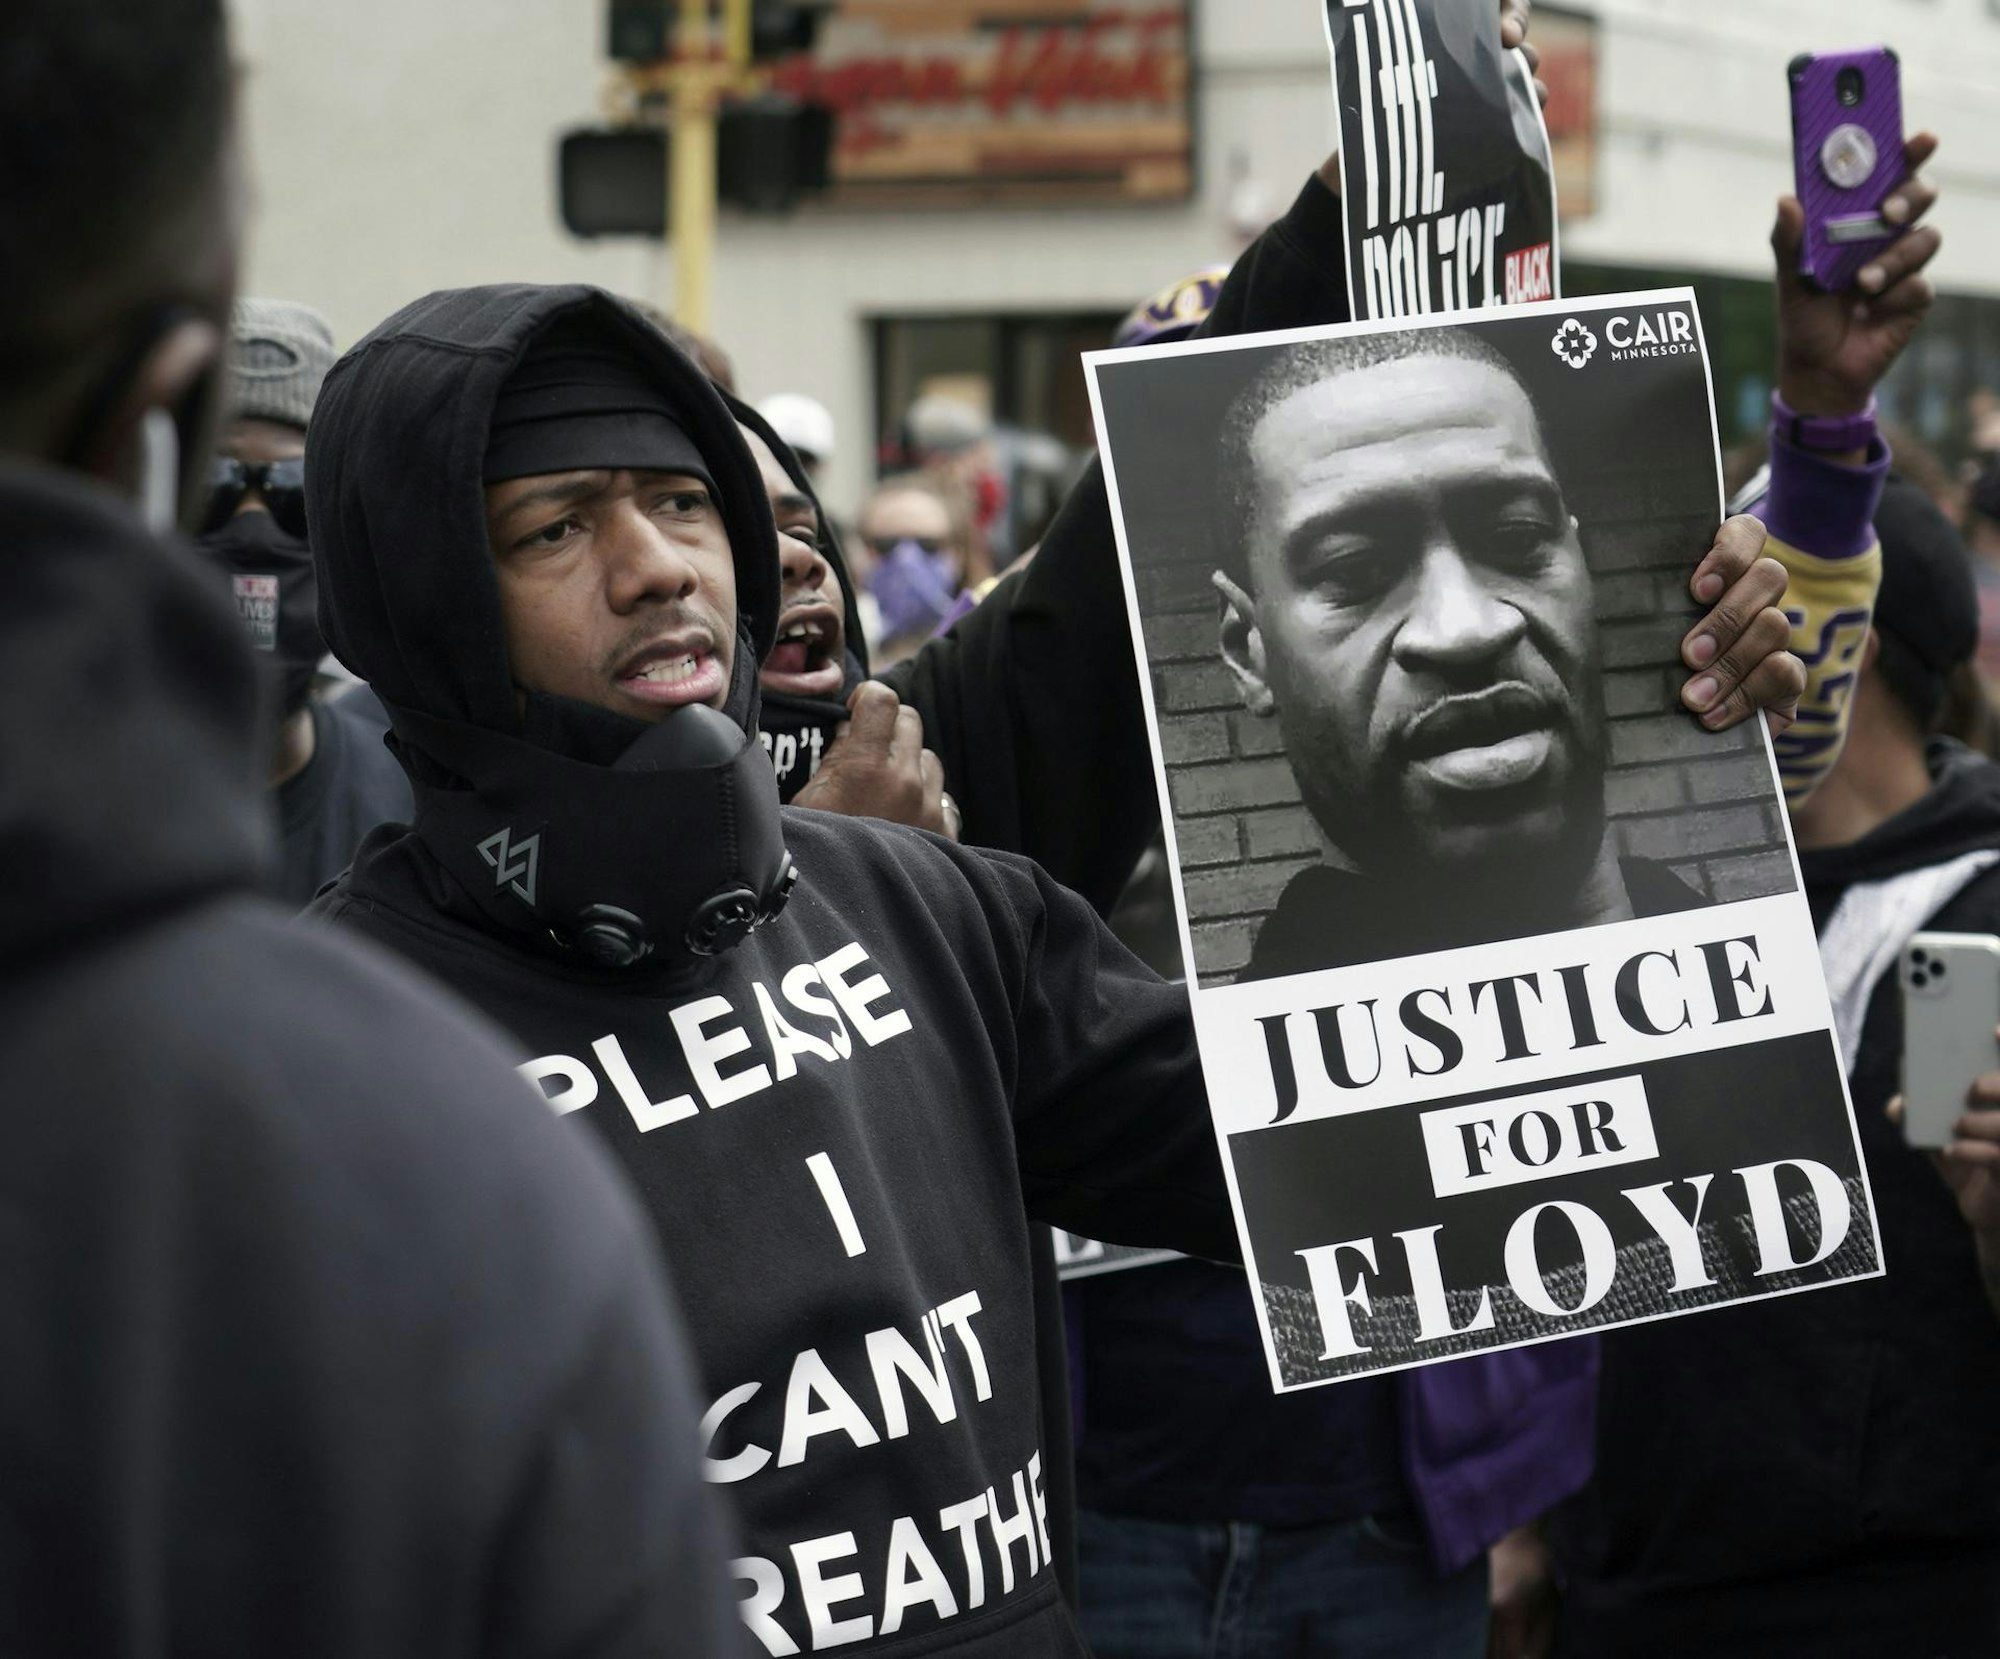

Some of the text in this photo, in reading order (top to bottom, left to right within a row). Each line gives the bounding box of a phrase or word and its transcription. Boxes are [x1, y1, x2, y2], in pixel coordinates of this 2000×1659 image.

[1505, 246, 1551, 304] BLACK
[1605, 310, 1694, 349] CAIR
[1610, 342, 1698, 362] MINNESOTA
[513, 941, 913, 1133] PLEASE
[1253, 934, 1775, 1125] JUSTICE
[805, 1151, 867, 1258] I
[1455, 1099, 1627, 1179] FOR
[1293, 1158, 1852, 1362] FLOYD
[699, 1289, 993, 1485] CAN'T
[728, 1448, 1052, 1659] REATHE
